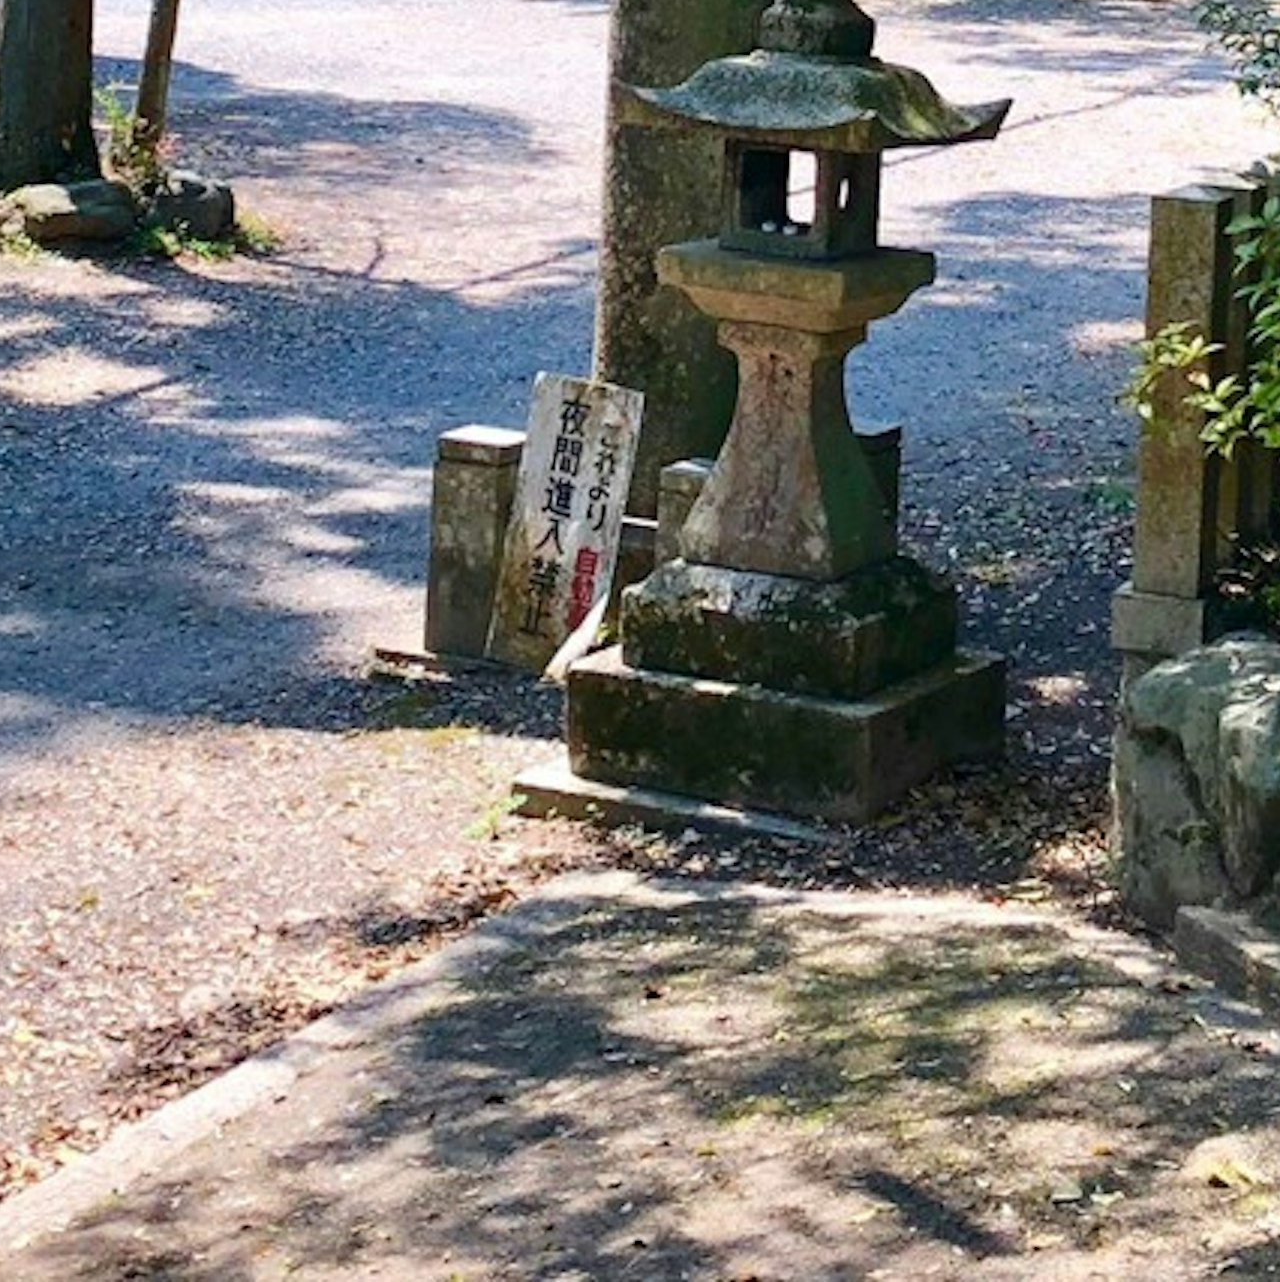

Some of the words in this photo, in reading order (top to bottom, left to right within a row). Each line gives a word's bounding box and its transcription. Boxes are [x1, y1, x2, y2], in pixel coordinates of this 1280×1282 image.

[520, 400, 591, 638] 夜間進入禁止
